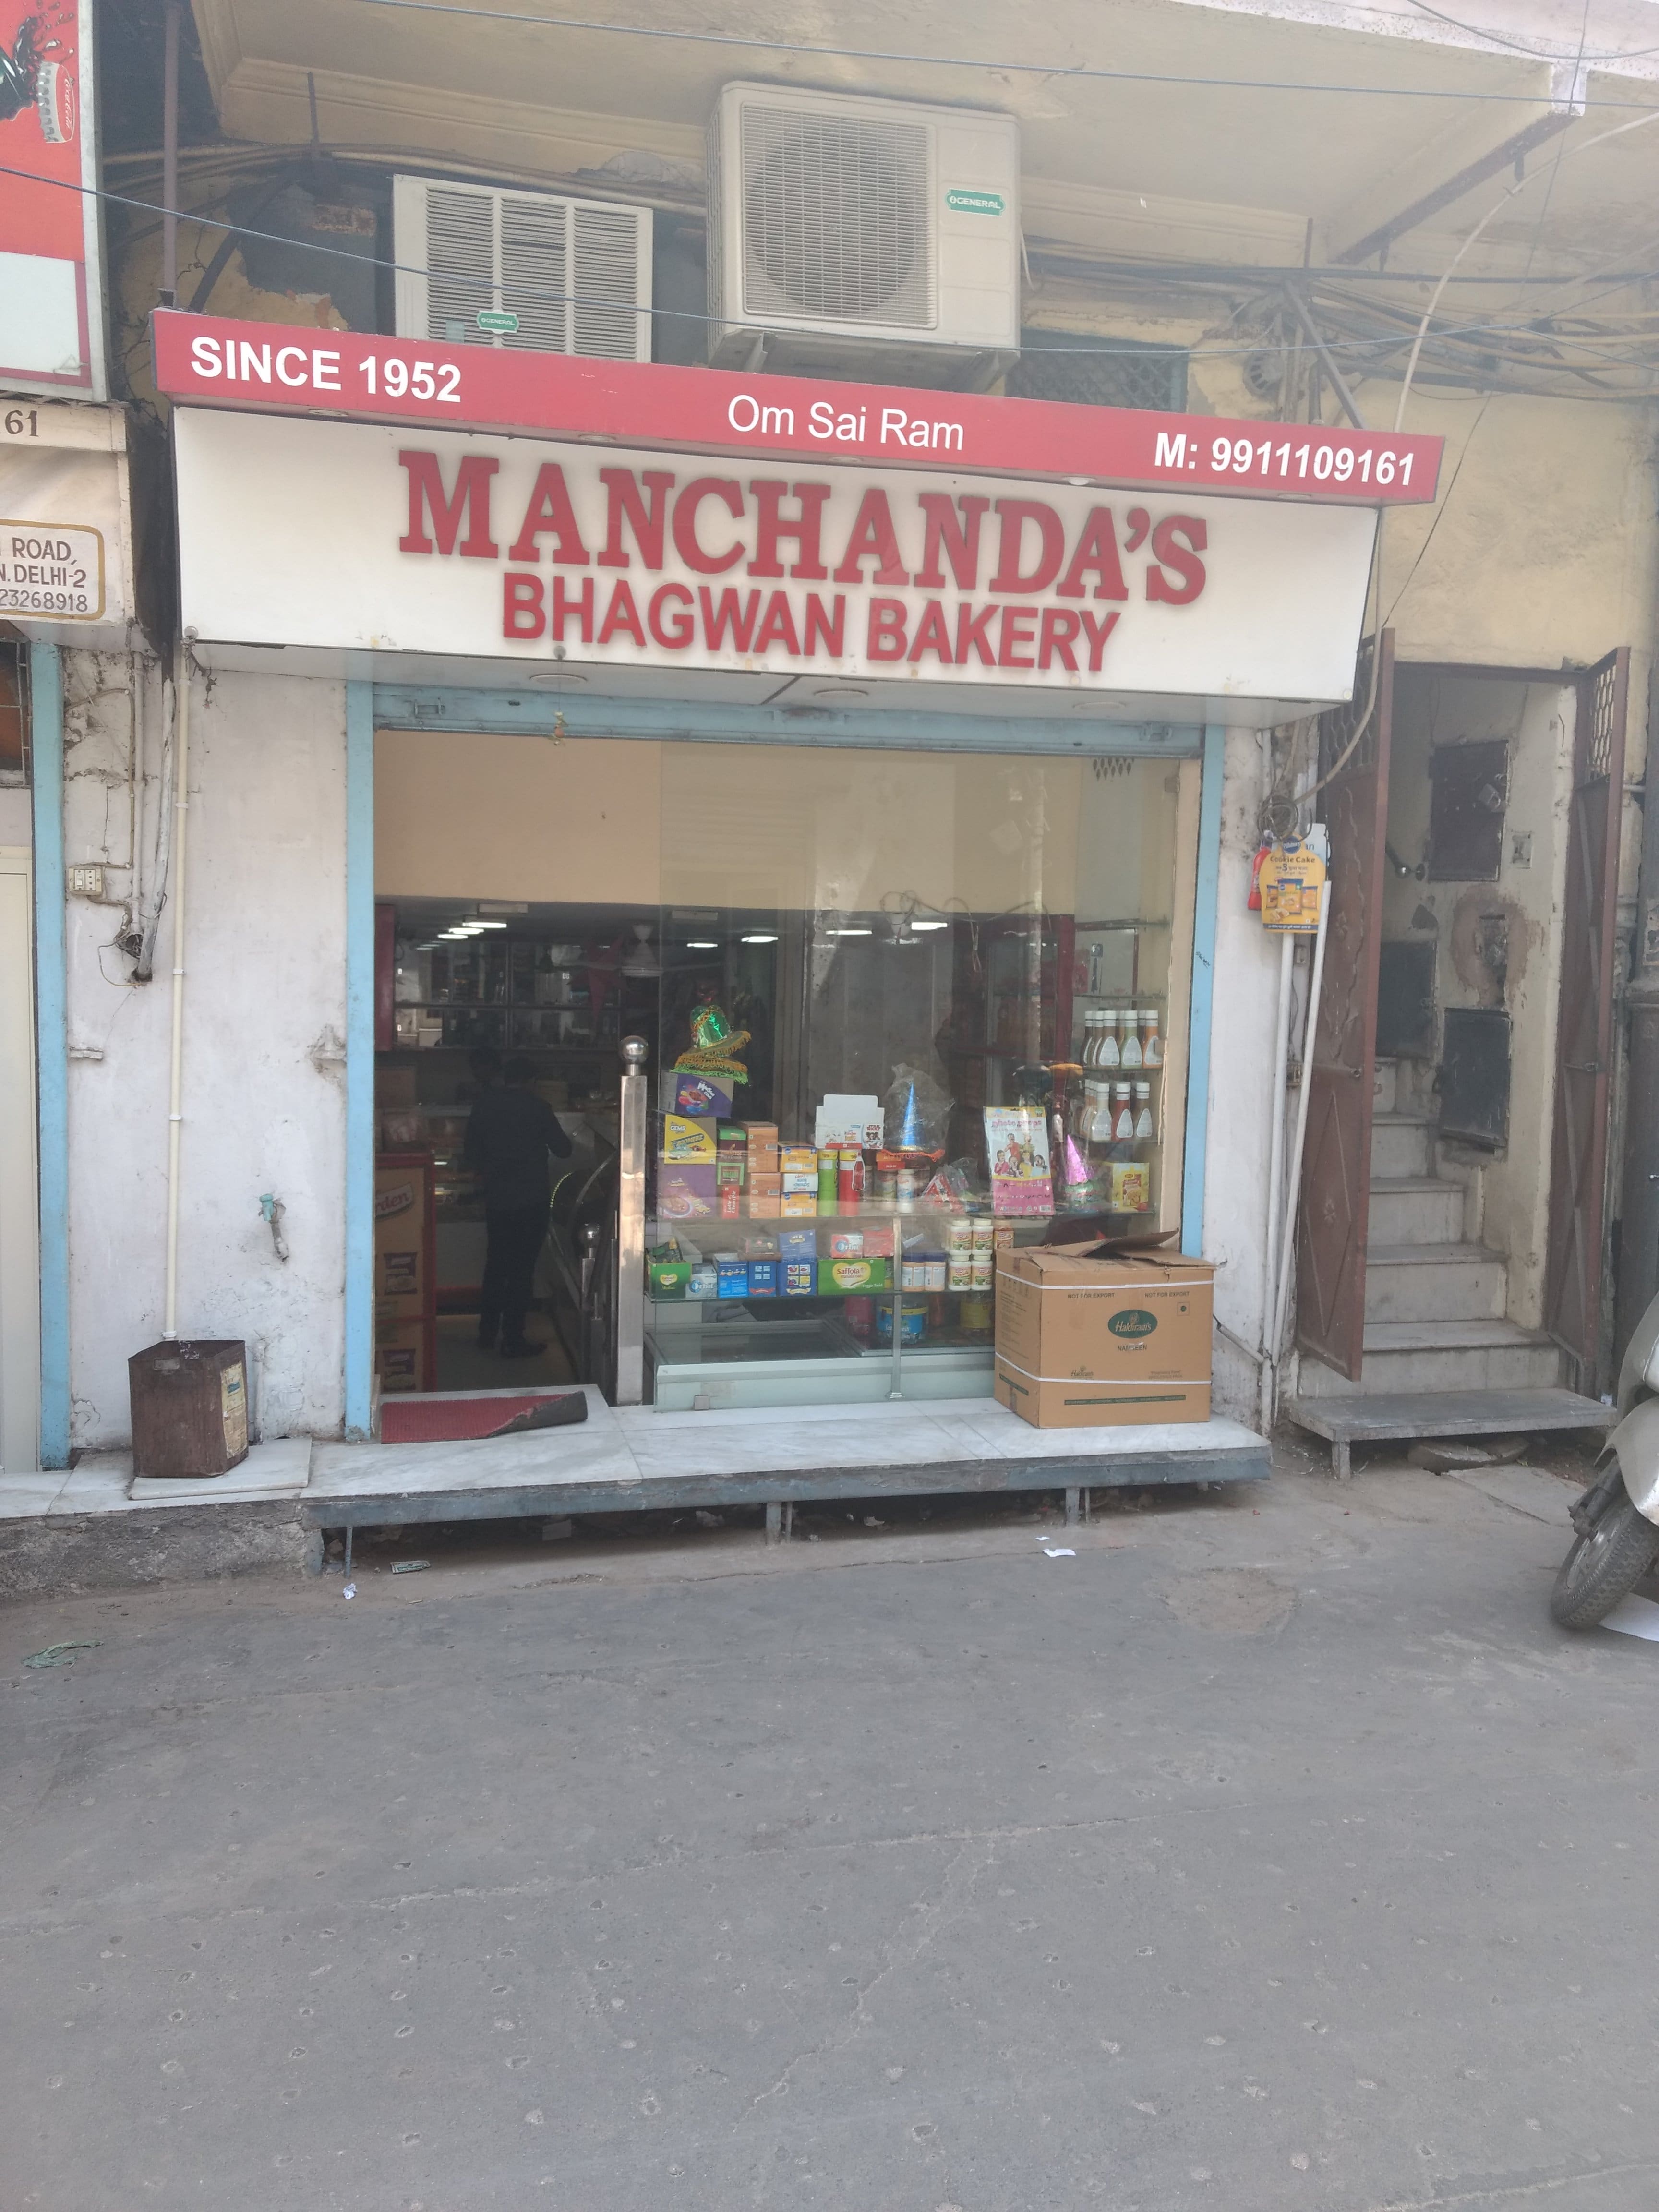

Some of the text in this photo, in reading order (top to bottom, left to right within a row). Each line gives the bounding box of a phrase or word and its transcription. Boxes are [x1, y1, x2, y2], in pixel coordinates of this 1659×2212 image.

[191, 336, 461, 403] SINCE 1952
[728, 394, 964, 450] Om Sai Ram
[1154, 432, 1414, 486] M: 9911109161
[12, 537, 77, 565] ROAD,
[397, 450, 1209, 605] MANCHANDA'S
[0, 589, 88, 612] 23268918
[503, 572, 1121, 673] BHAGWAN BAKERY
[1115, 1320, 1152, 1332] Haldiram's
